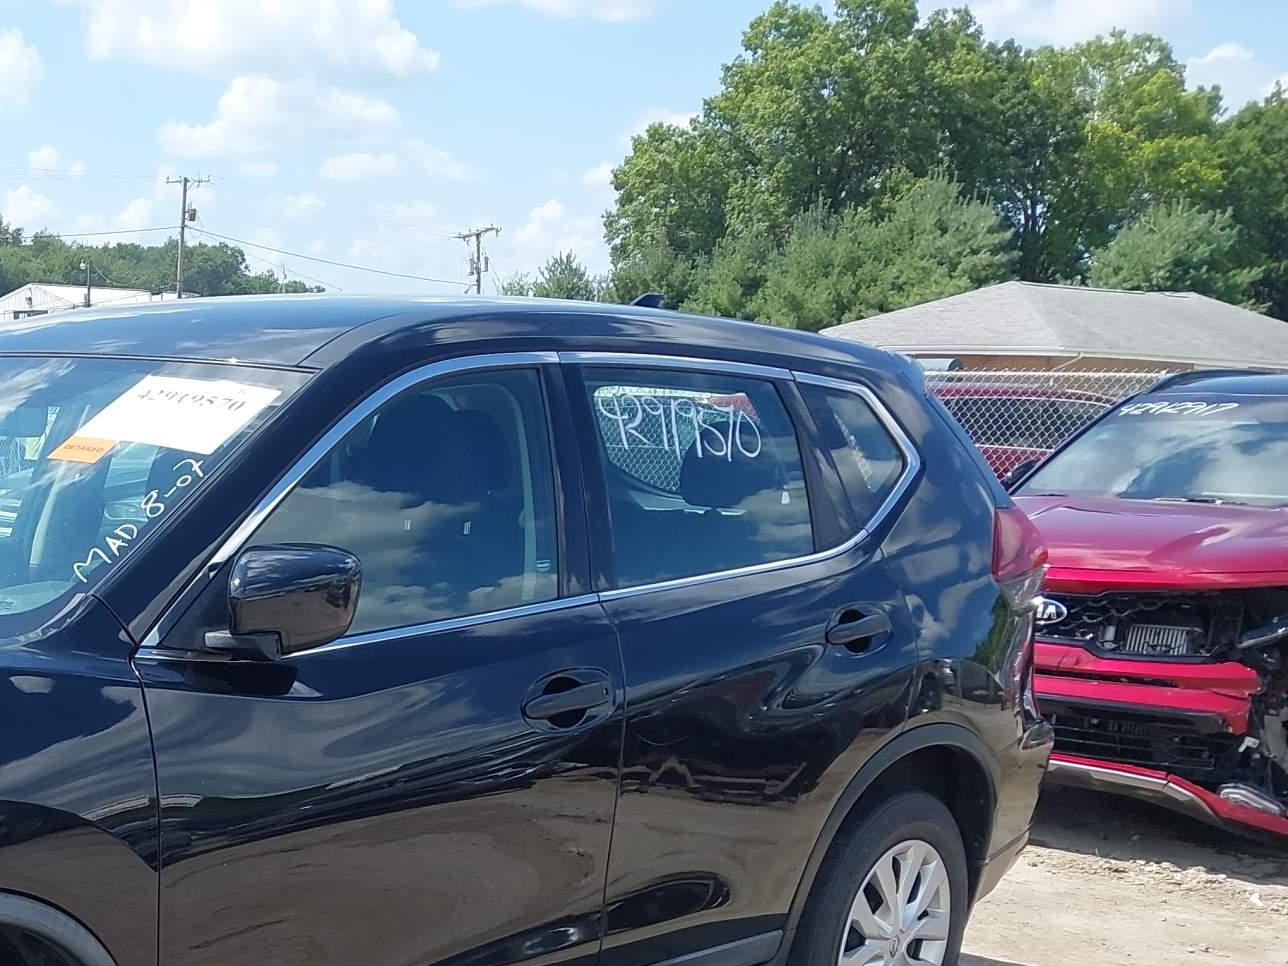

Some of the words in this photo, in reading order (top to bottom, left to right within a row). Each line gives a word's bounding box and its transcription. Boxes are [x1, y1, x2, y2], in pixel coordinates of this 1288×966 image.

[598, 394, 762, 462] 42919570
[73, 524, 138, 583] MAD
[140, 458, 204, 518] 8-07
[1036, 603, 1057, 620] IA
